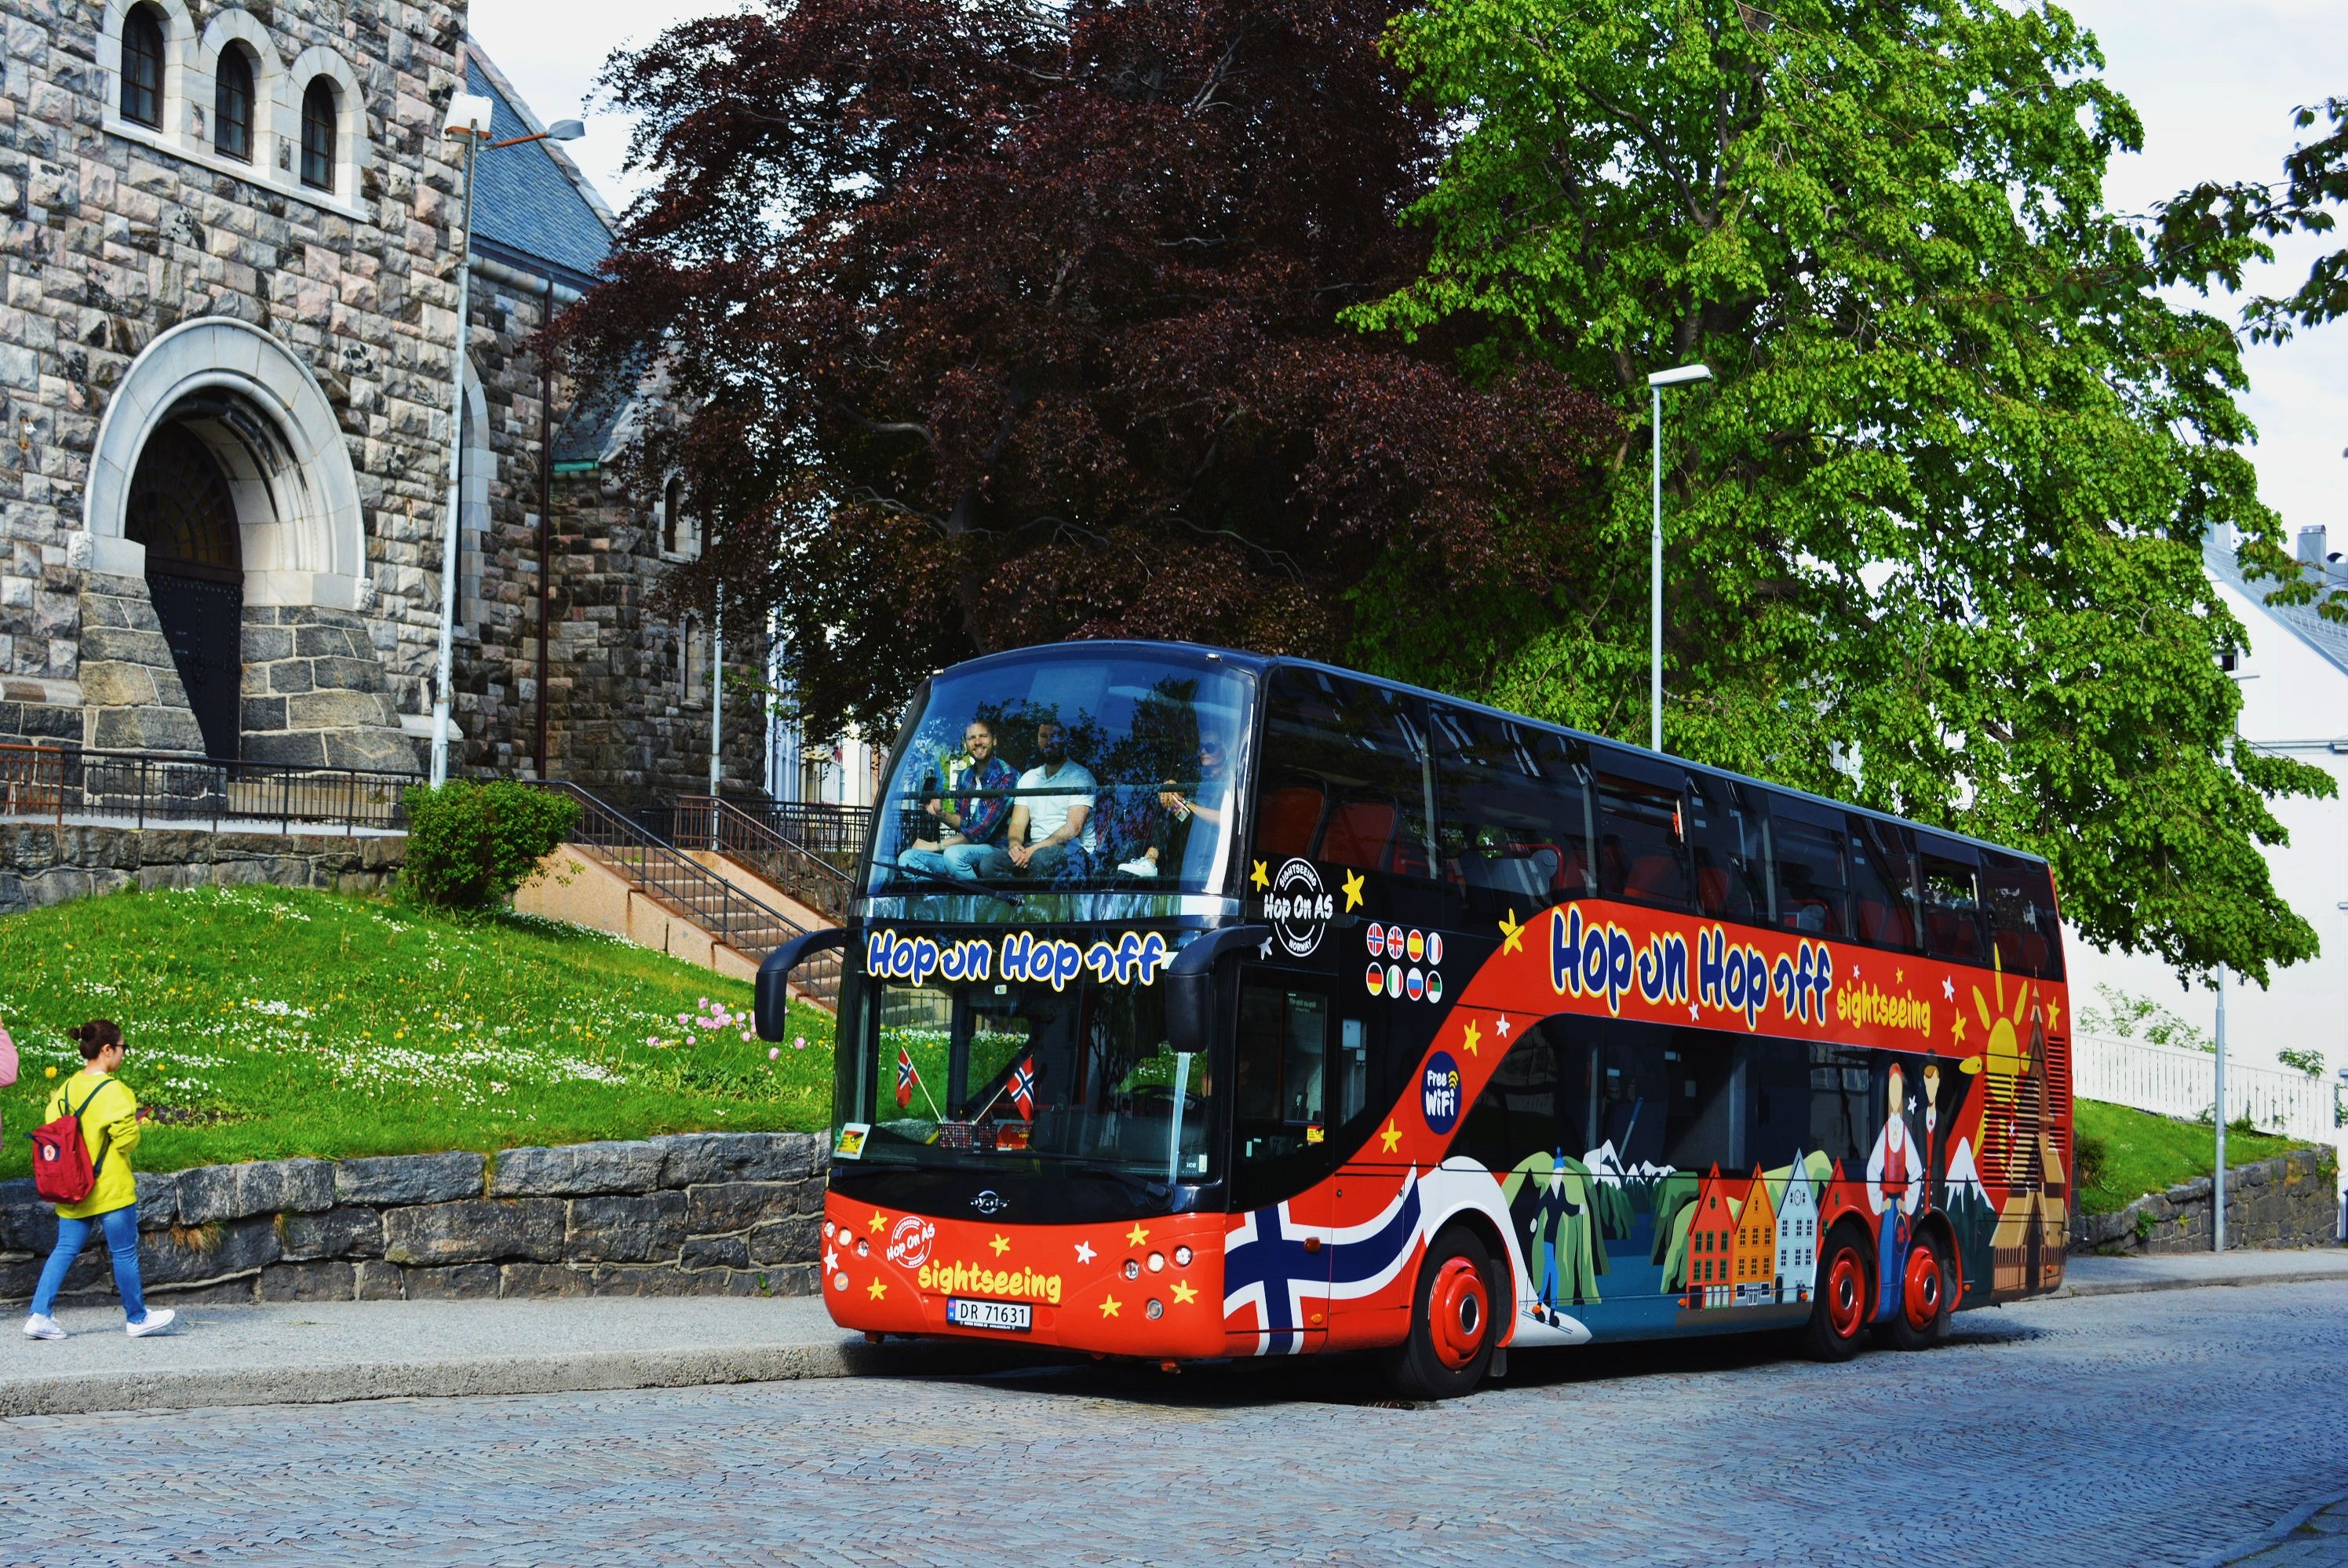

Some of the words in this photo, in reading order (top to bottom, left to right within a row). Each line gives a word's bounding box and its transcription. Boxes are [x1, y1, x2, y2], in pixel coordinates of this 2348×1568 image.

[1279, 864, 1317, 888] SIGHTSEEING
[1264, 892, 1291, 924] Hop
[1294, 895, 1311, 920] On
[1314, 894, 1333, 920] AS
[867, 928, 939, 987] Hop
[939, 939, 993, 981] on
[1000, 931, 1083, 993] Hop
[1083, 931, 1166, 986] off
[1289, 939, 1311, 952] NORWAY
[1550, 902, 1635, 1017] Hop
[1636, 932, 1688, 1005] on
[1697, 924, 1769, 1032] Hop
[1771, 938, 1832, 1026] off
[1836, 979, 1931, 1037] sightseeing
[1427, 1070, 1447, 1087] Free
[1426, 1088, 1454, 1117] WiFi
[886, 1242, 906, 1261] Hop
[906, 1233, 921, 1249] On
[921, 1223, 935, 1242] AS
[918, 1259, 1061, 1304] sightseeing
[961, 1304, 978, 1319] DR
[986, 1305, 1024, 1323] 71631
